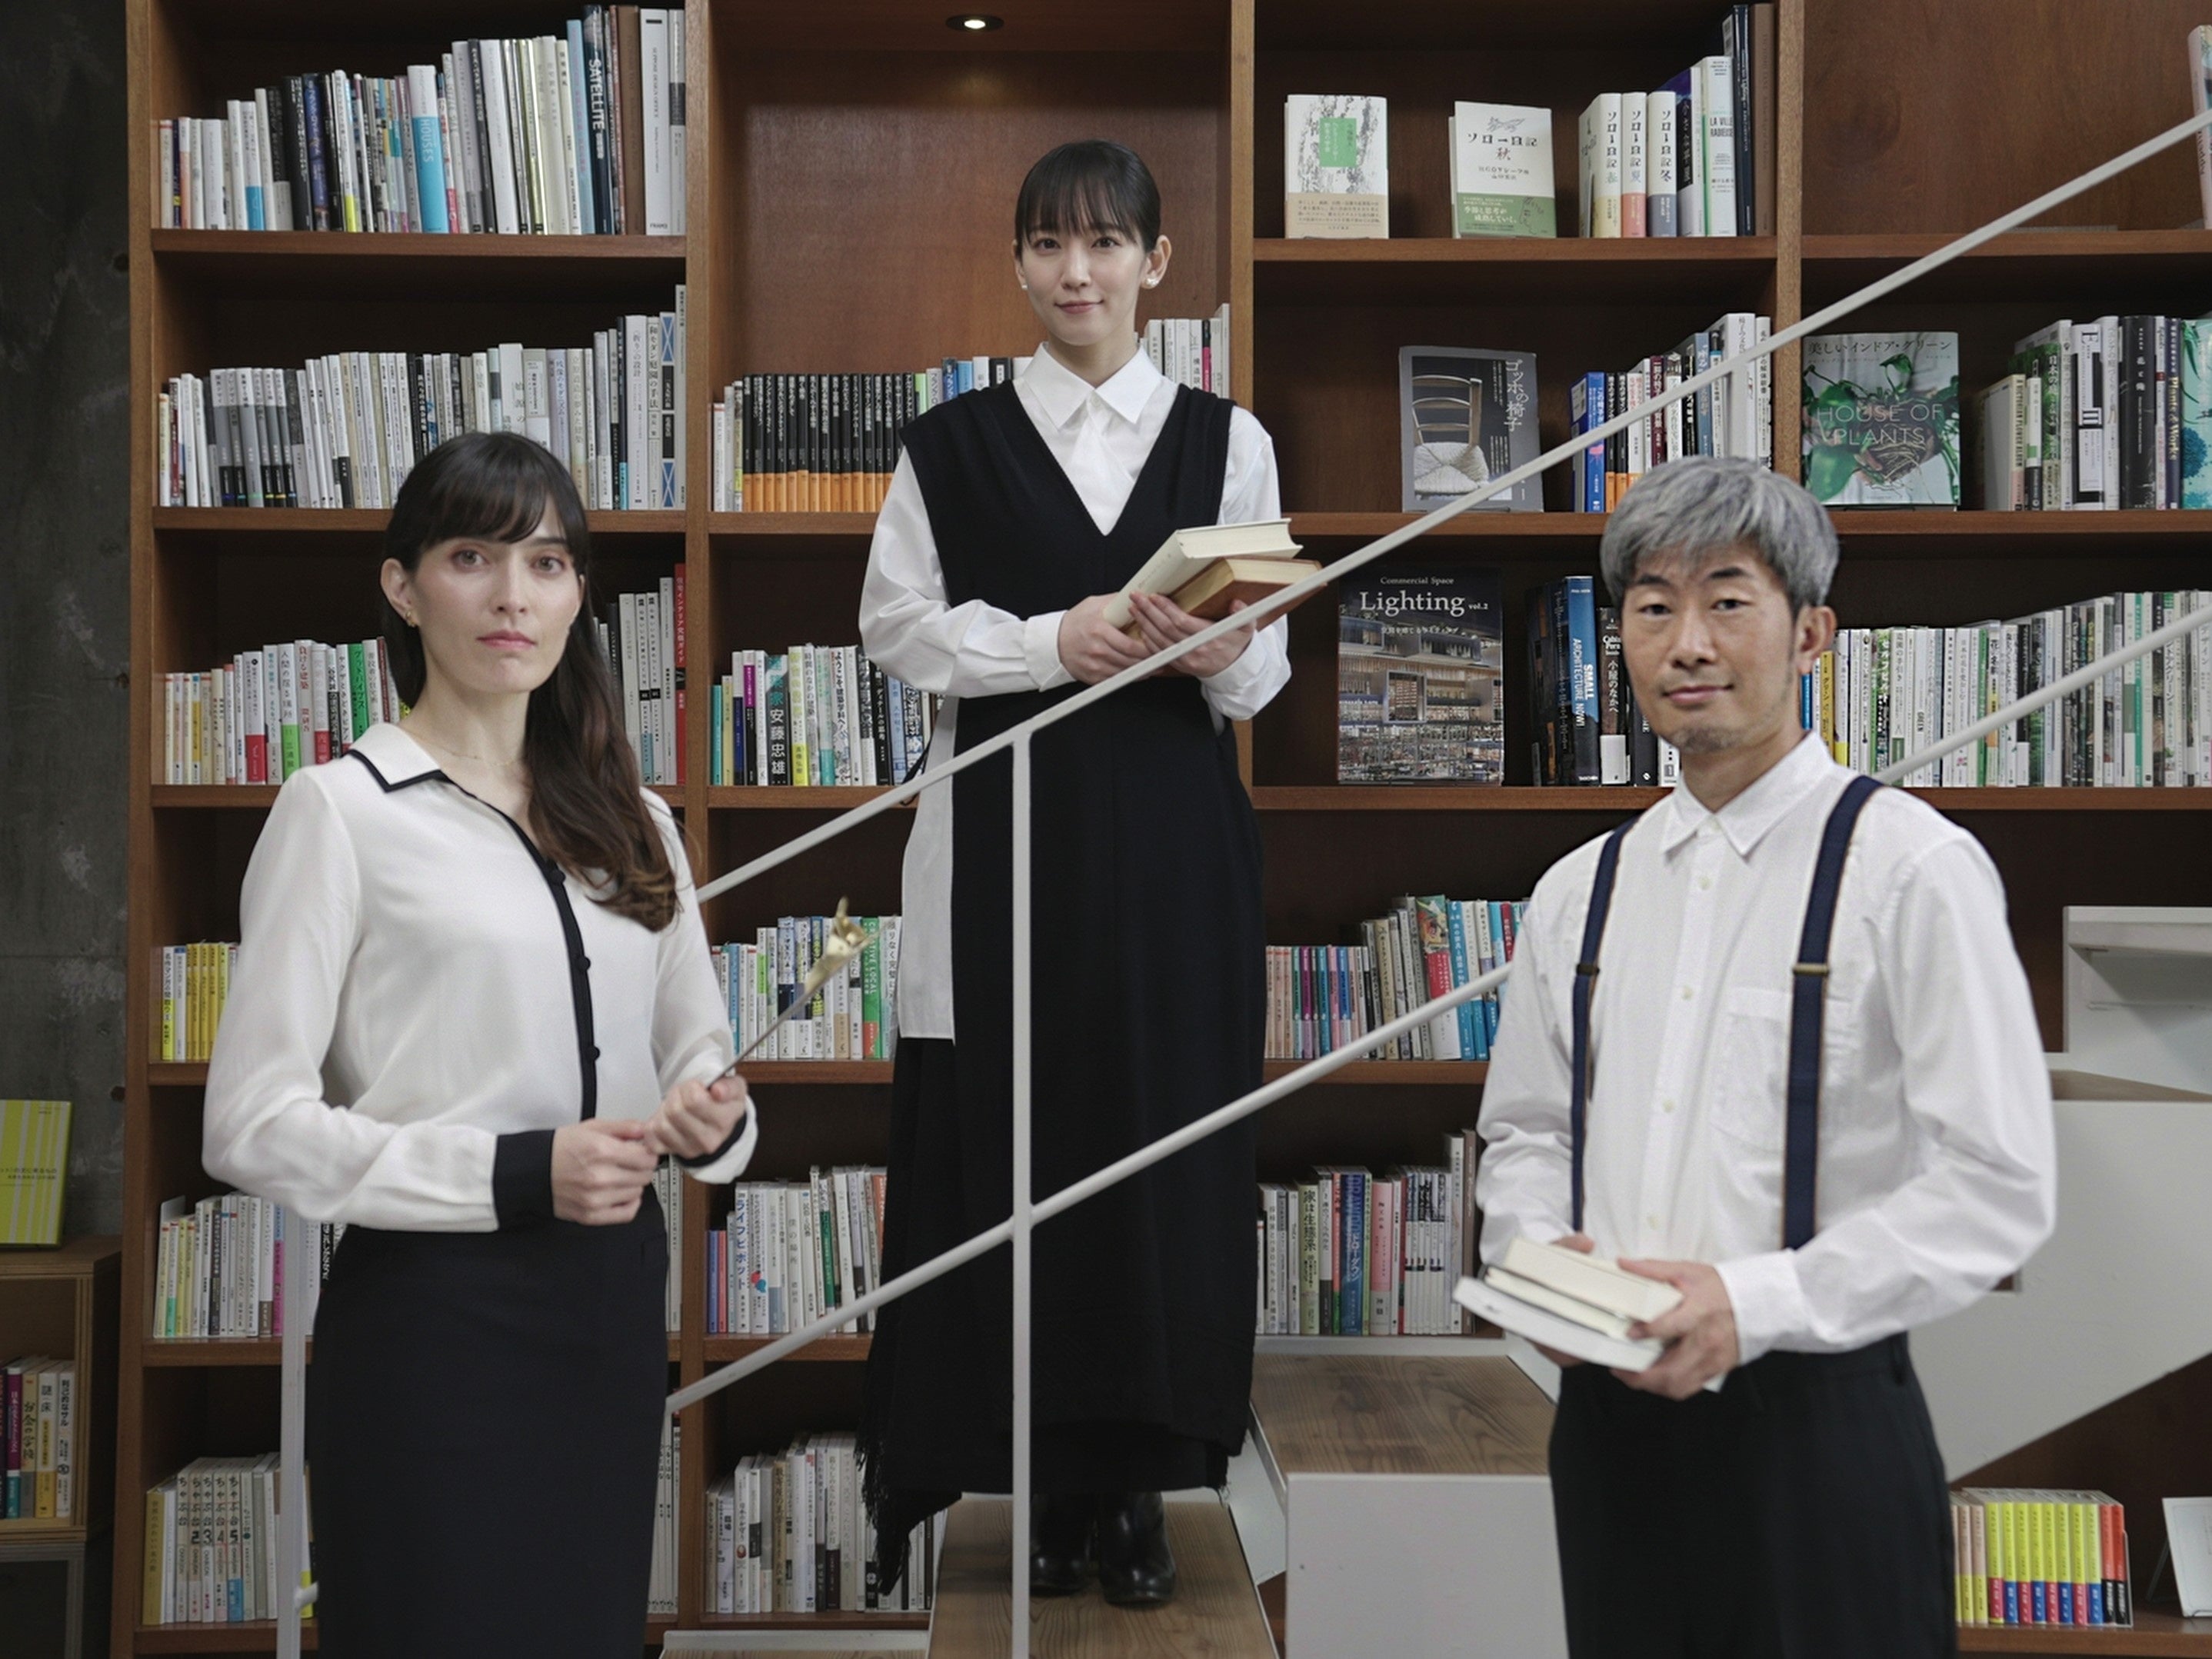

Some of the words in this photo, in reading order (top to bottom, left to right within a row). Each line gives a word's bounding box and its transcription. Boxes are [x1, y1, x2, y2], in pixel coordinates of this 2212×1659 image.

[588, 58, 605, 129] SATELLITE
[421, 119, 434, 162] HOUSES
[1467, 132, 1537, 147] ソロー日記
[1496, 147, 1511, 161] 秋
[1809, 340, 1952, 355] 美しいインドア・グリーン
[1504, 358, 1530, 433] ゴッホの椅子
[1817, 405, 1901, 422] HOUSE
[1910, 404, 1943, 420] OF
[1834, 427, 1927, 446] PLANTS
[1431, 577, 1454, 586] Space
[1360, 590, 1465, 617] Lighting
[1573, 638, 1583, 701] ARCHITECTURE
[1583, 665, 1594, 700] SMALL
[868, 921, 877, 962] CRTIVE
[870, 966, 878, 994] LOCAL
[1303, 1190, 1317, 1252] 家は生態系
